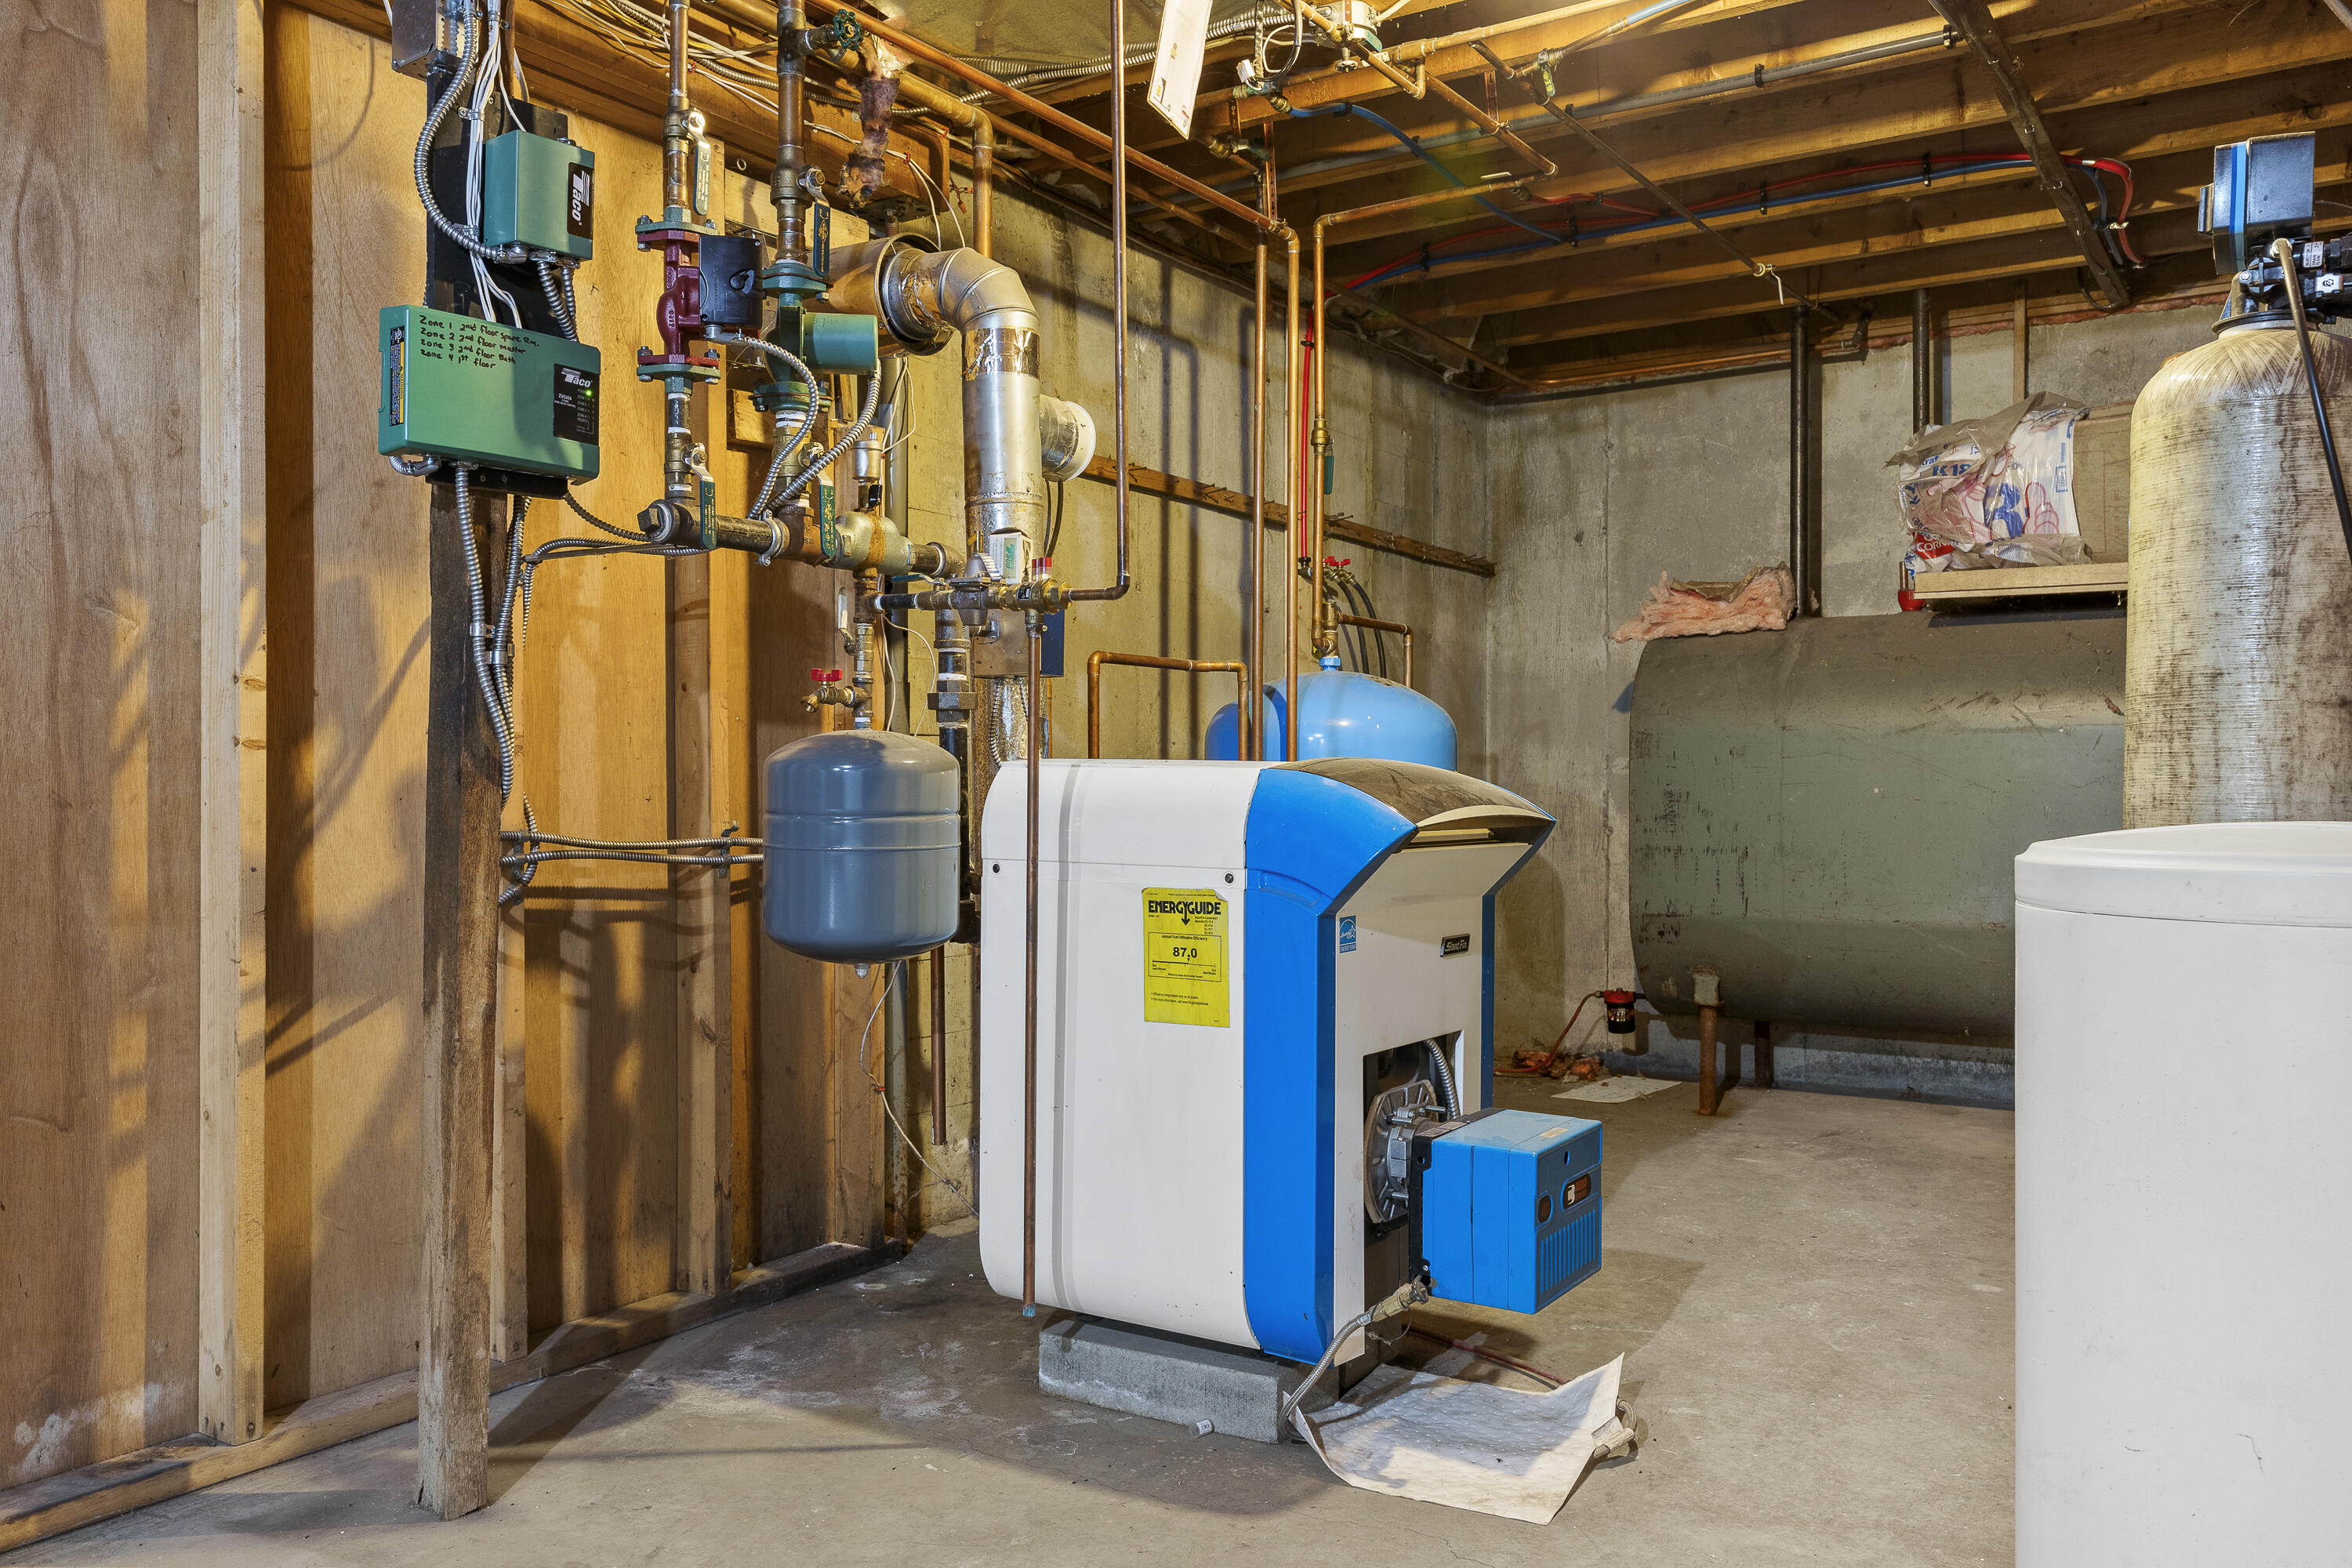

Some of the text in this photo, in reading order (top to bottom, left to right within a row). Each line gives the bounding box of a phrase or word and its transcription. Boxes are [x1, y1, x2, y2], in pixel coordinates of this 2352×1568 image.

[572, 169, 590, 221] Taco
[419, 314, 445, 328] Zone
[480, 325, 499, 336] floor
[477, 336, 496, 348] floor
[458, 345, 474, 354] 2nd
[476, 347, 495, 359] floor
[499, 354, 516, 365] Bath
[458, 354, 469, 364] 1st
[474, 358, 496, 368] floor
[561, 368, 591, 387] Taco
[1148, 900, 1221, 915] ENERGYGUIDE
[1173, 947, 1197, 958] 87.0
